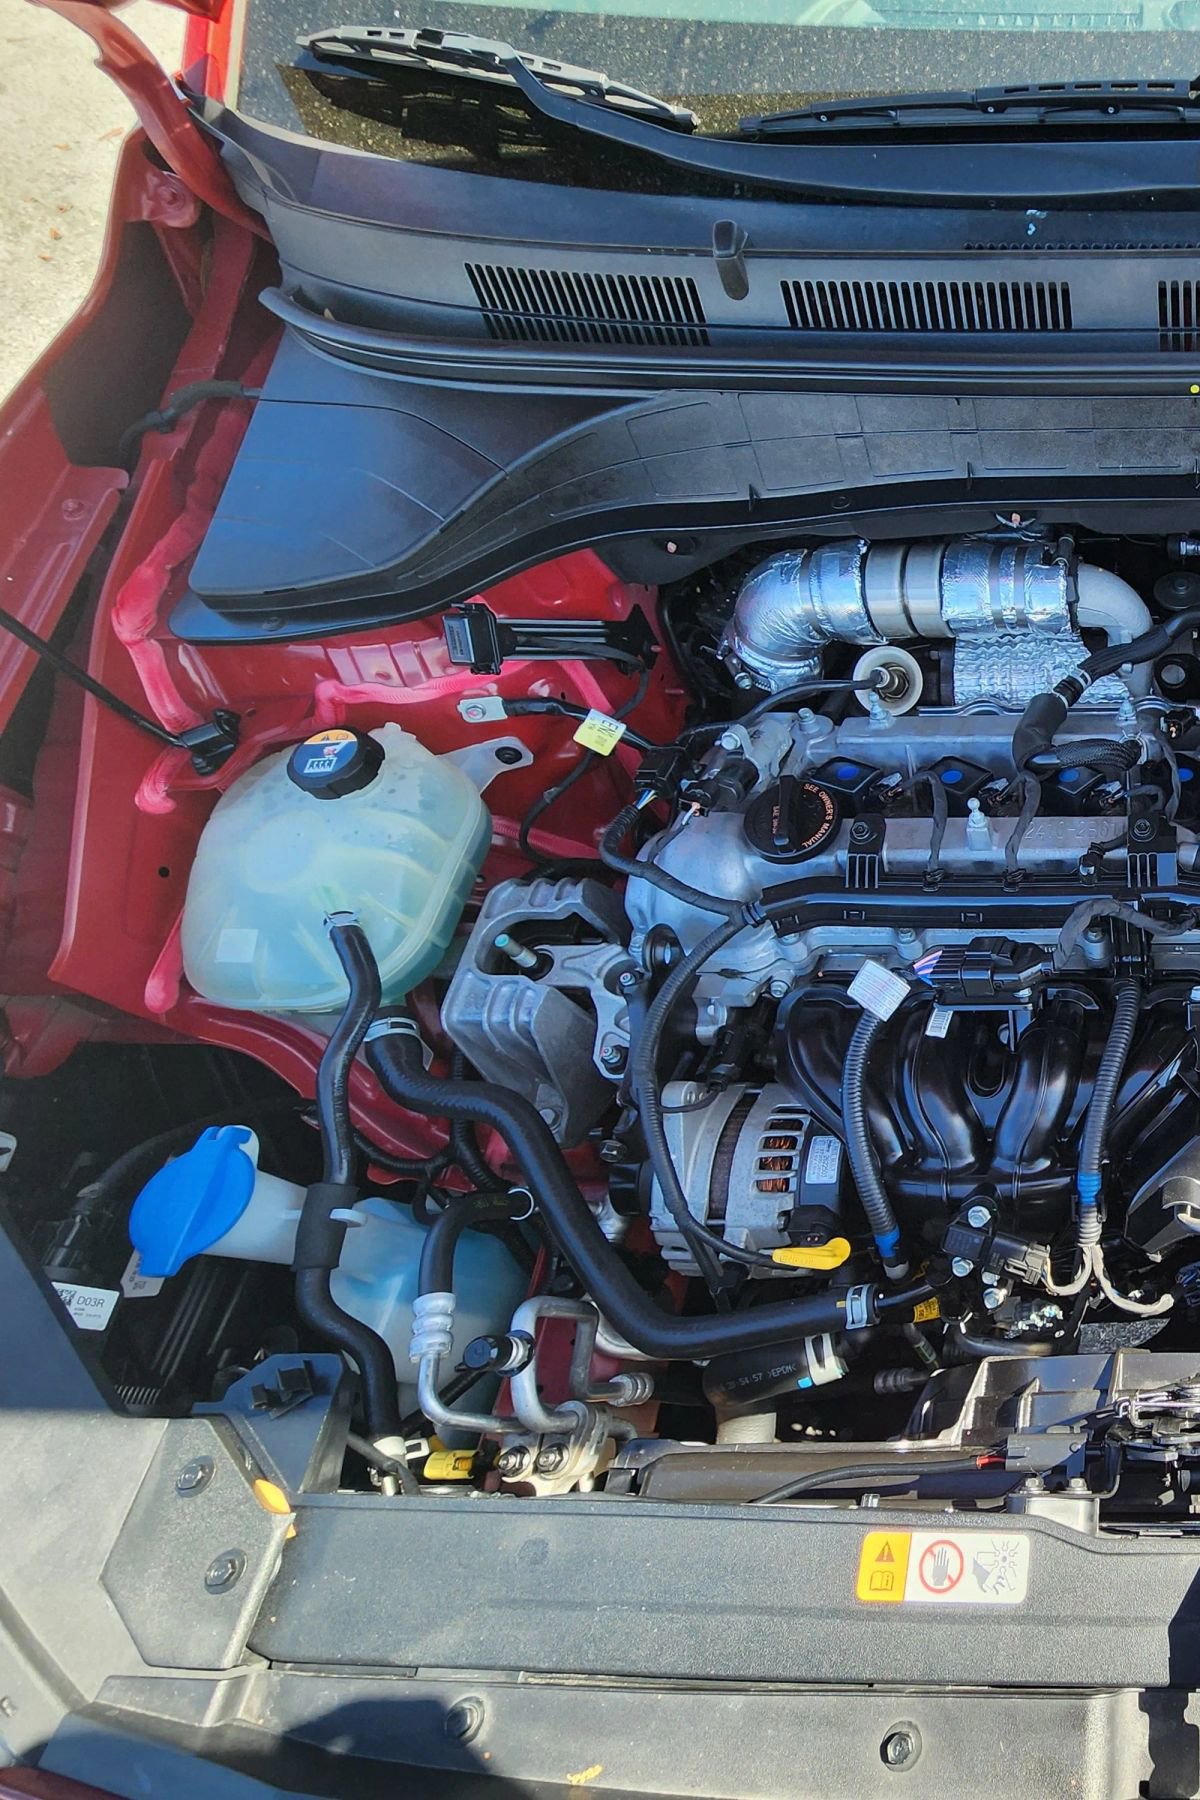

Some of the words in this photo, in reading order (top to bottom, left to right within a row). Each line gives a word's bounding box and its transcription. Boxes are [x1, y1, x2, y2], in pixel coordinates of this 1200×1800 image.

[803, 783, 819, 795] SEE
[818, 791, 834, 821] OWNER'S
[801, 822, 831, 848] MANUAL
[76, 1295, 105, 1308] D03R
